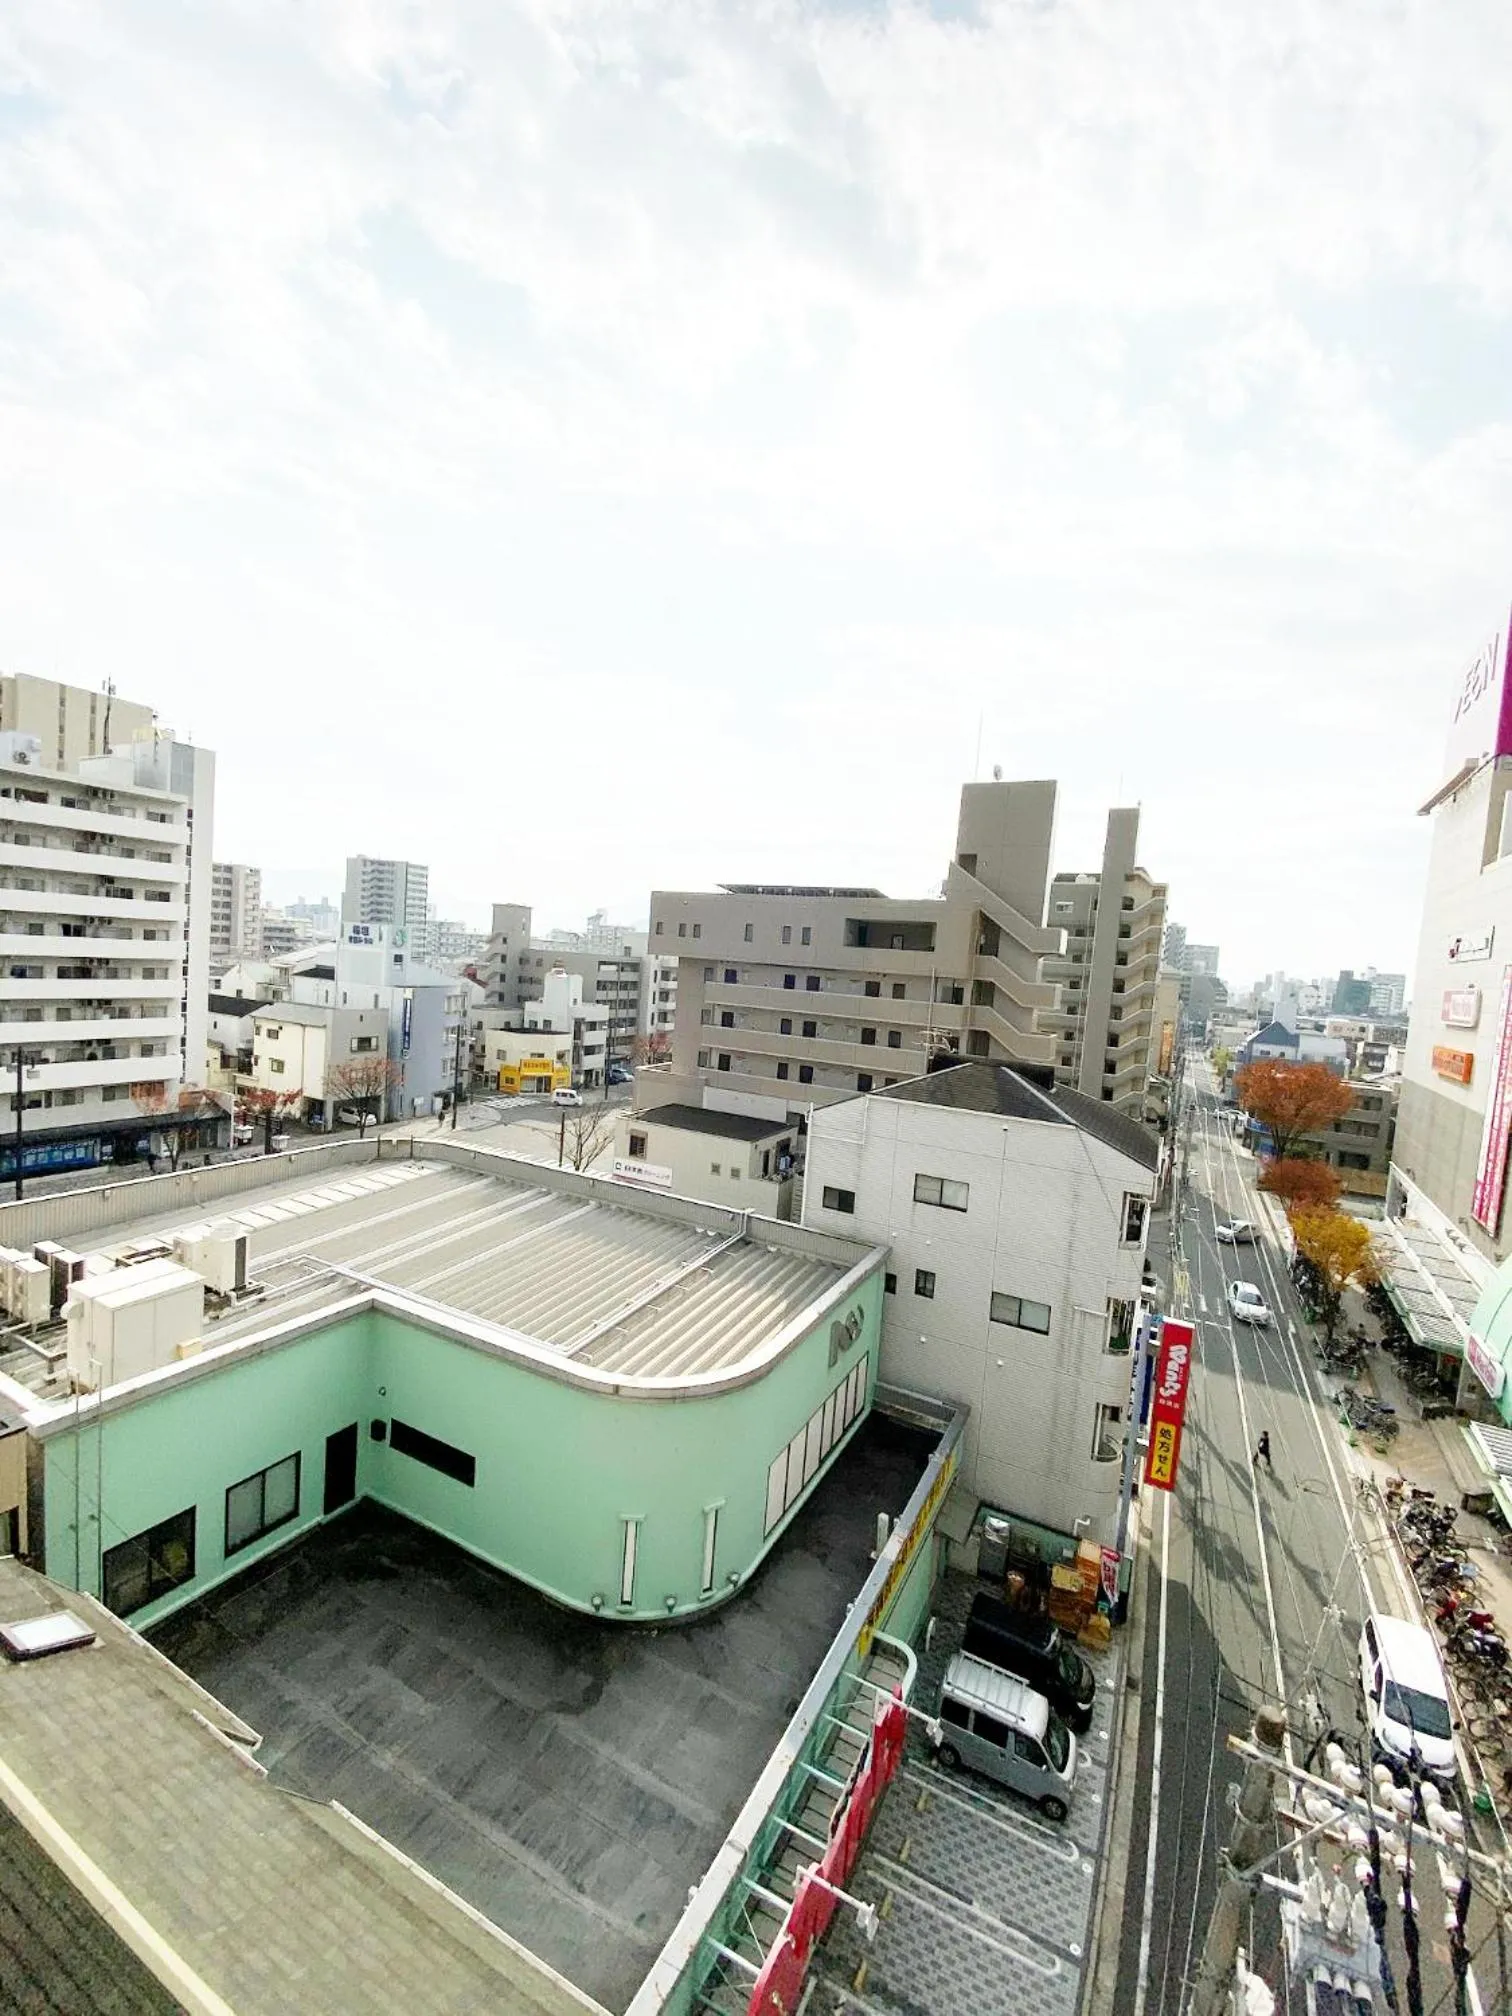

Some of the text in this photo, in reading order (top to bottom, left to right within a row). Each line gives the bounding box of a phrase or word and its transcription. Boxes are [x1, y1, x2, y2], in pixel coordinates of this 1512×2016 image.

[1159, 1344, 1188, 1398] Wants
[1155, 1427, 1172, 1478] 処方せん
